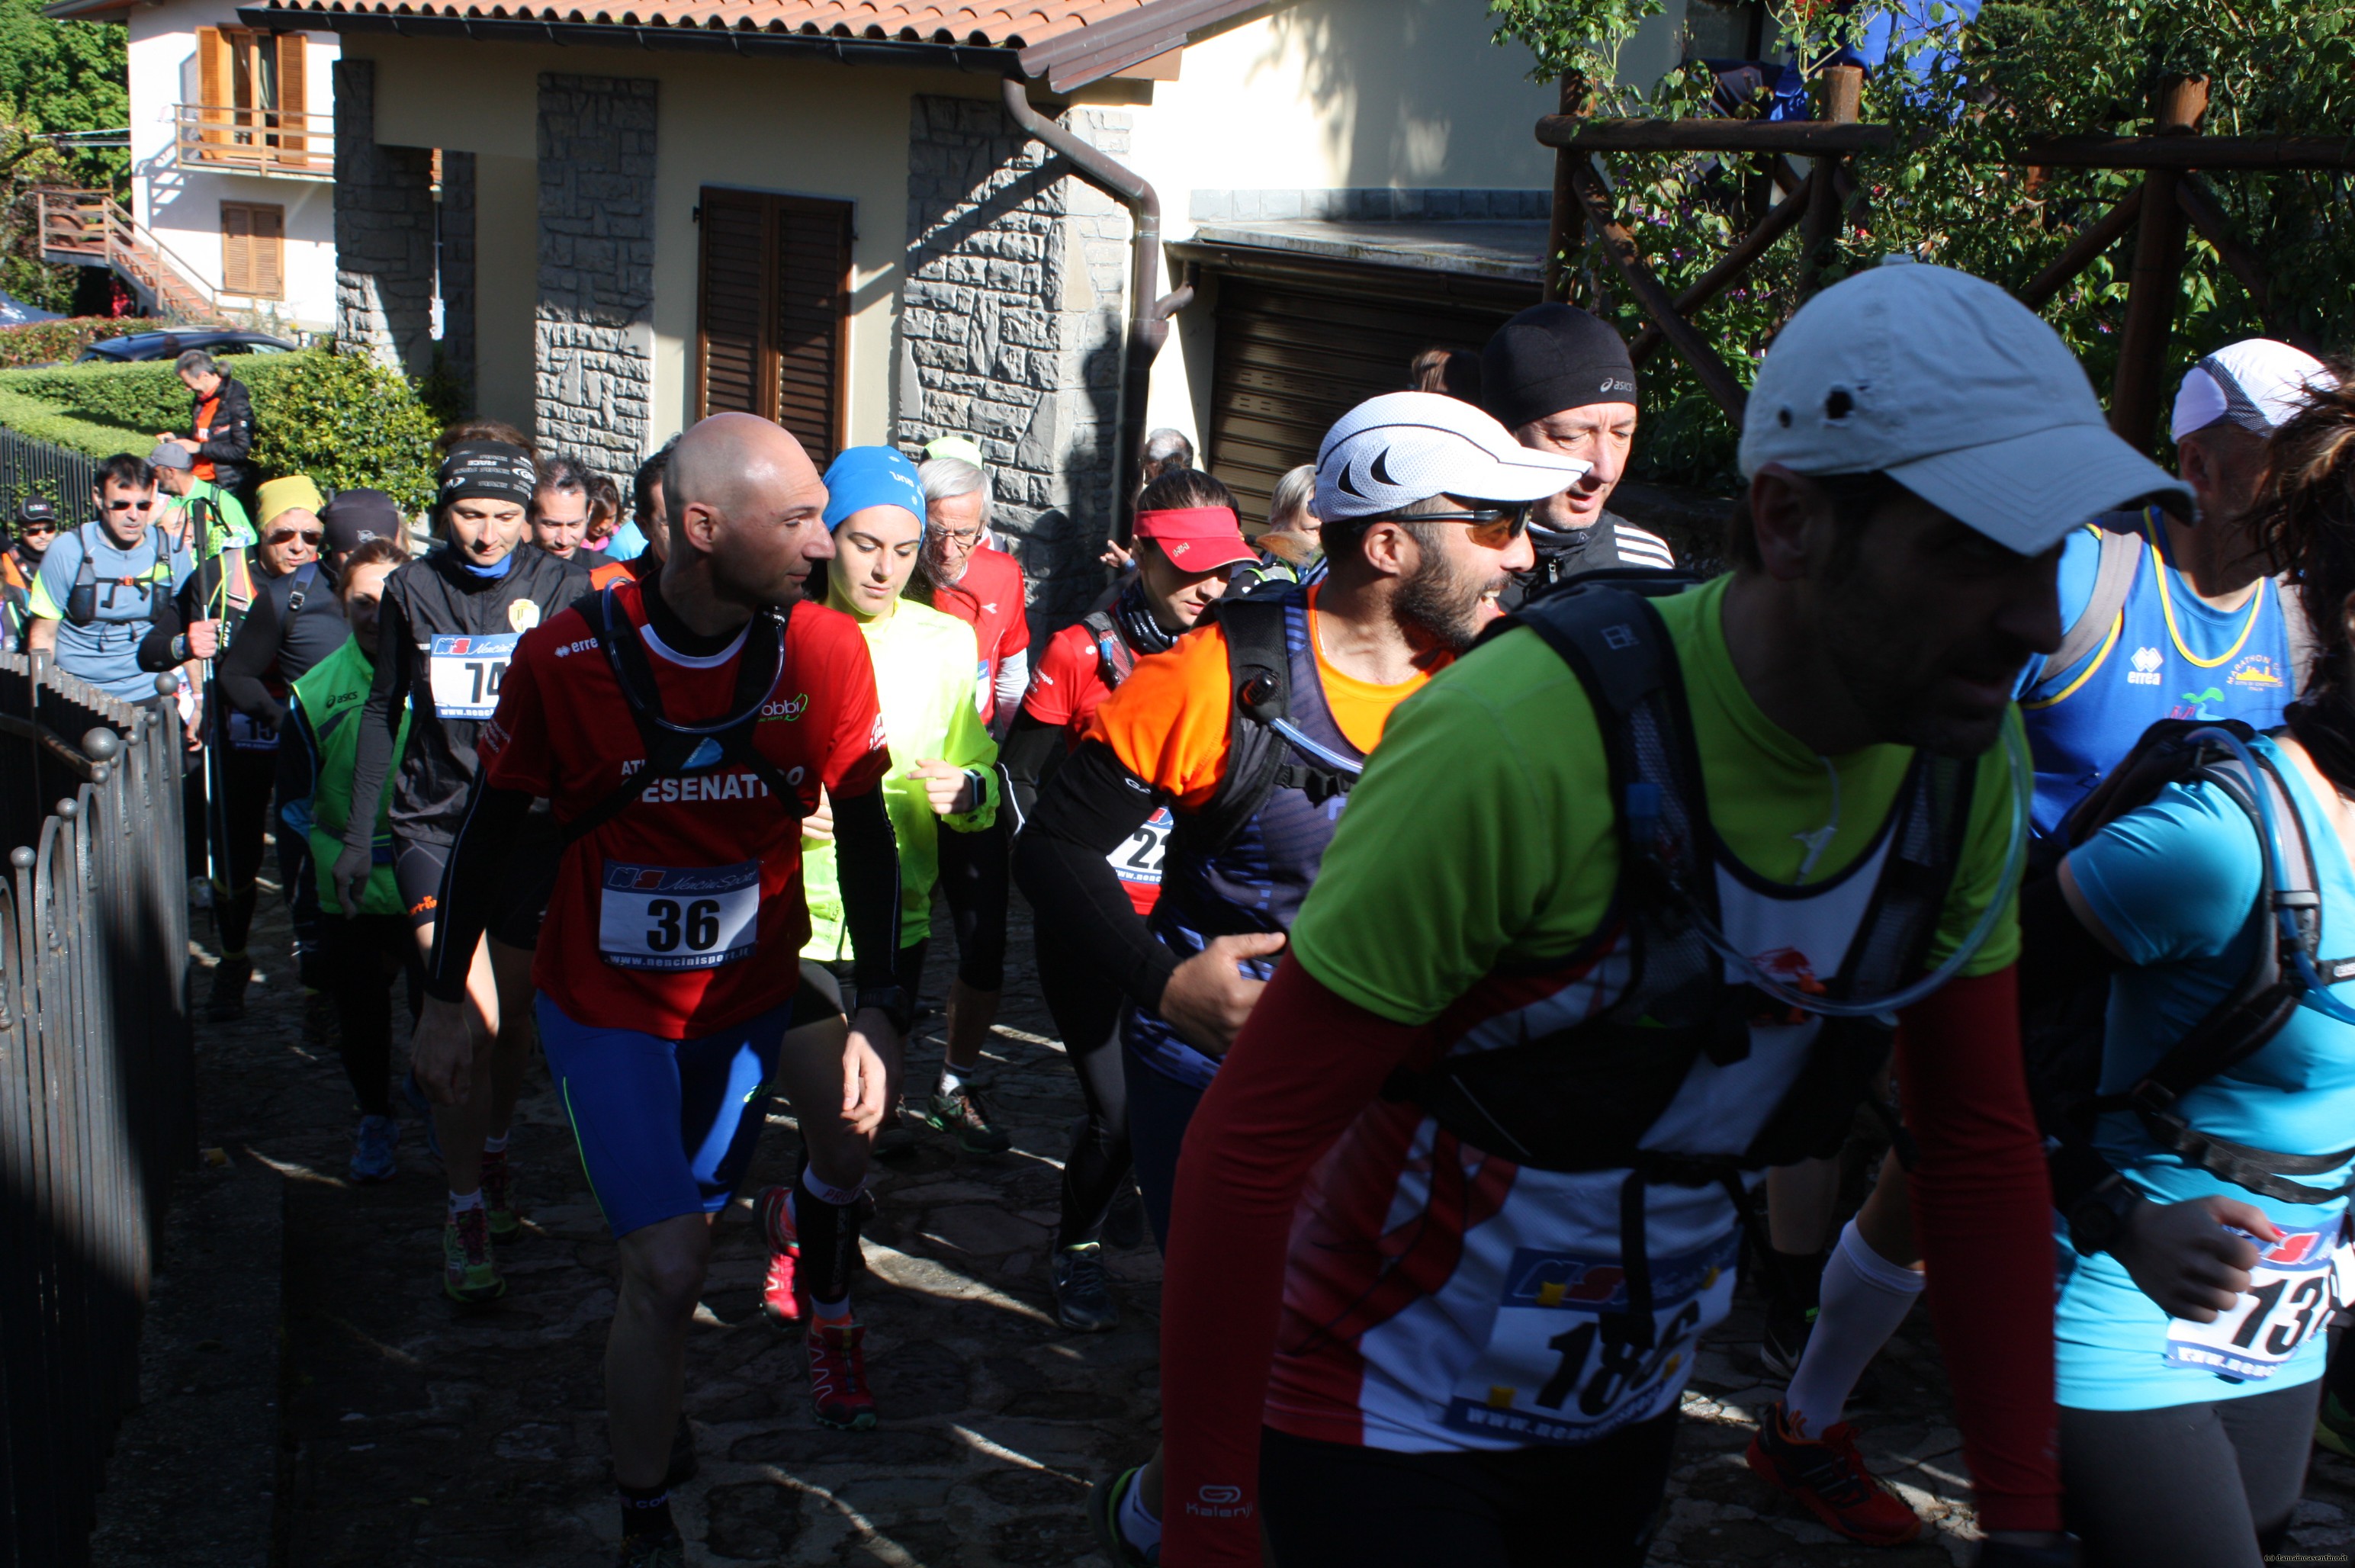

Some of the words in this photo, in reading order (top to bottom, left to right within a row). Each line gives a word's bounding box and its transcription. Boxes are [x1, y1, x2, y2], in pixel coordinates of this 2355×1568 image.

[1613, 381, 1634, 392] asics
[647, 898, 721, 953] 36
[609, 947, 750, 967] www.nencinisport.it
